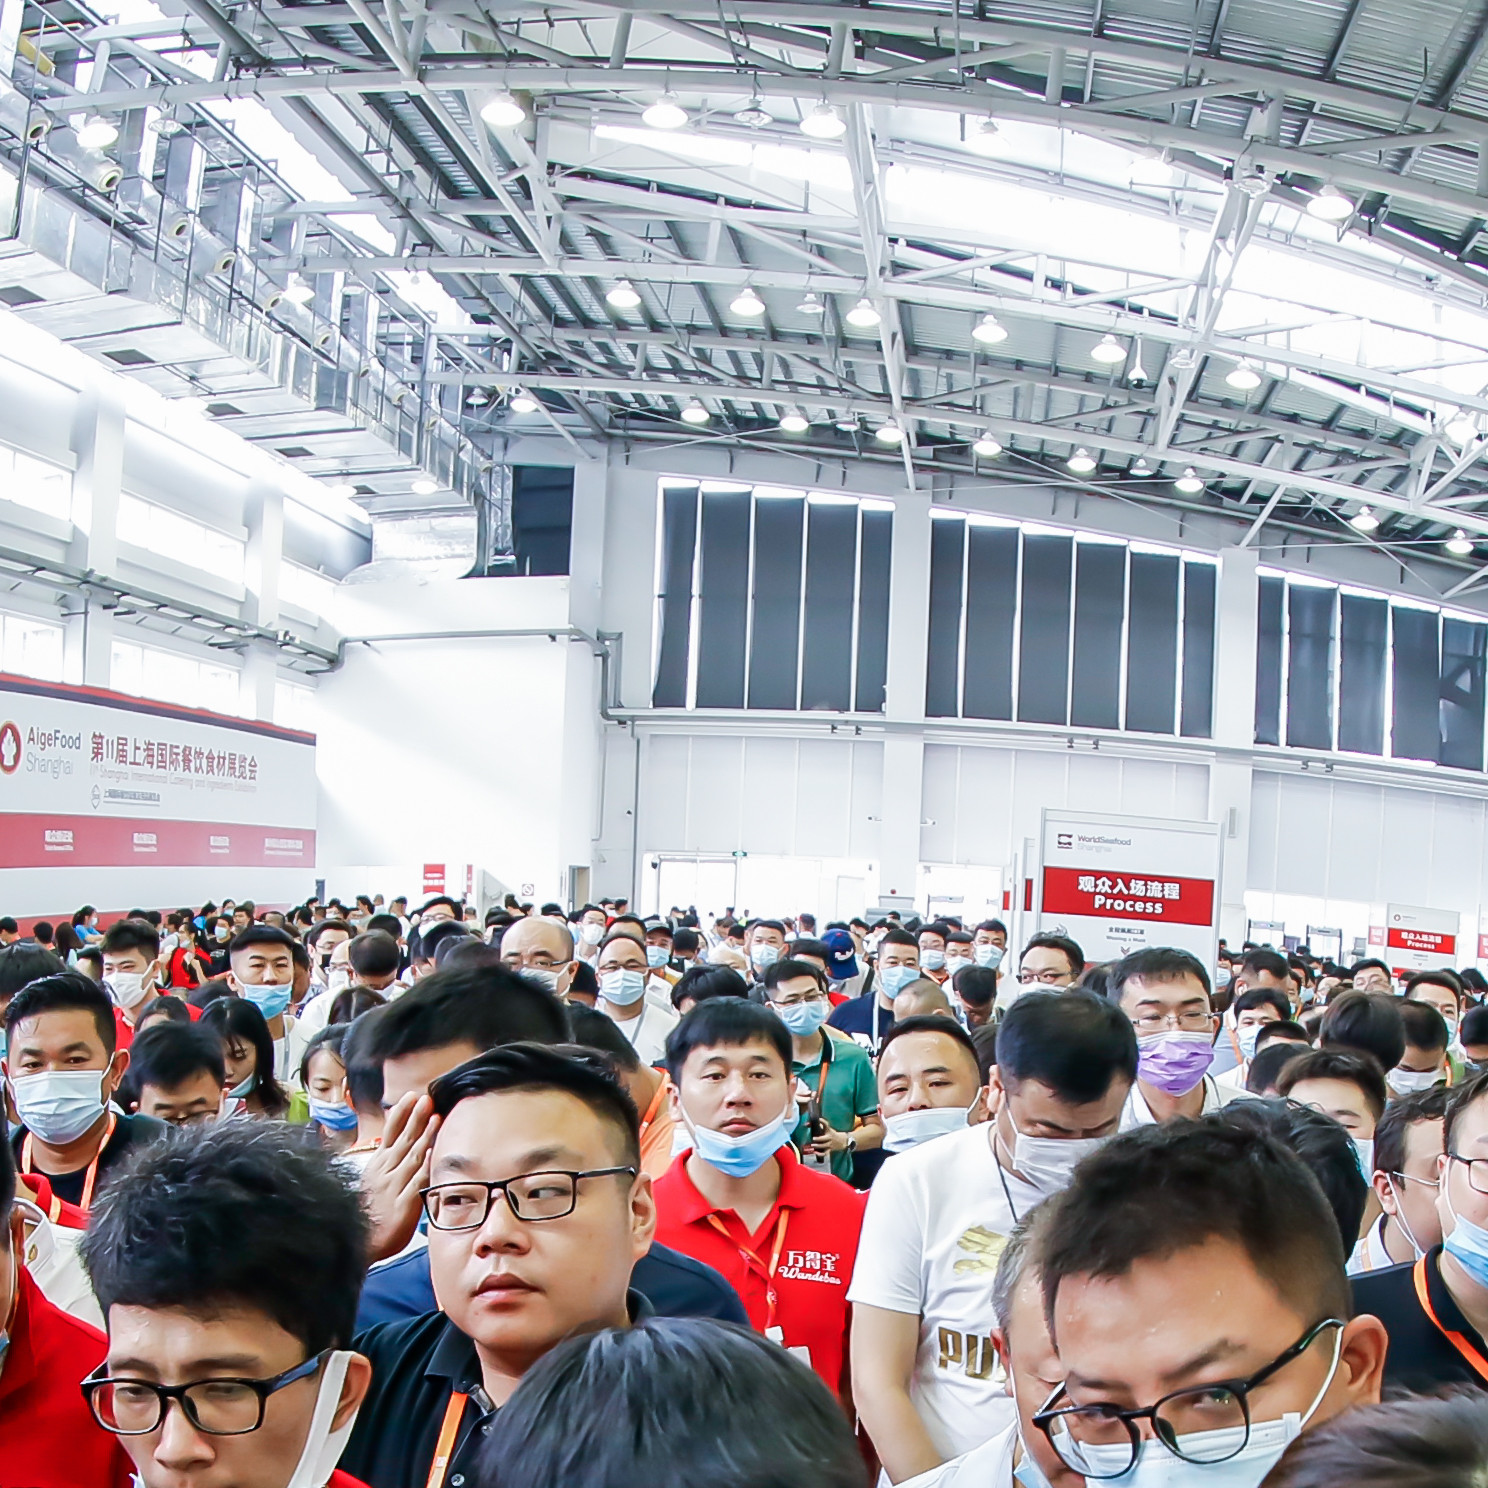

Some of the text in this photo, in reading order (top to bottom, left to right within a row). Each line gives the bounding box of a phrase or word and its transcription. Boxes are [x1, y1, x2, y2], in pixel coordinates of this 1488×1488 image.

[27, 727, 81, 751] AigeFood
[26, 751, 73, 779] Shanghai
[90, 732, 258, 782] 第11届上海国际餐饮食材展览会
[1077, 875, 1181, 900] 观众入场流程
[1094, 895, 1164, 914] Process
[1407, 940, 1436, 950] Process
[938, 1326, 1005, 1382] PU
